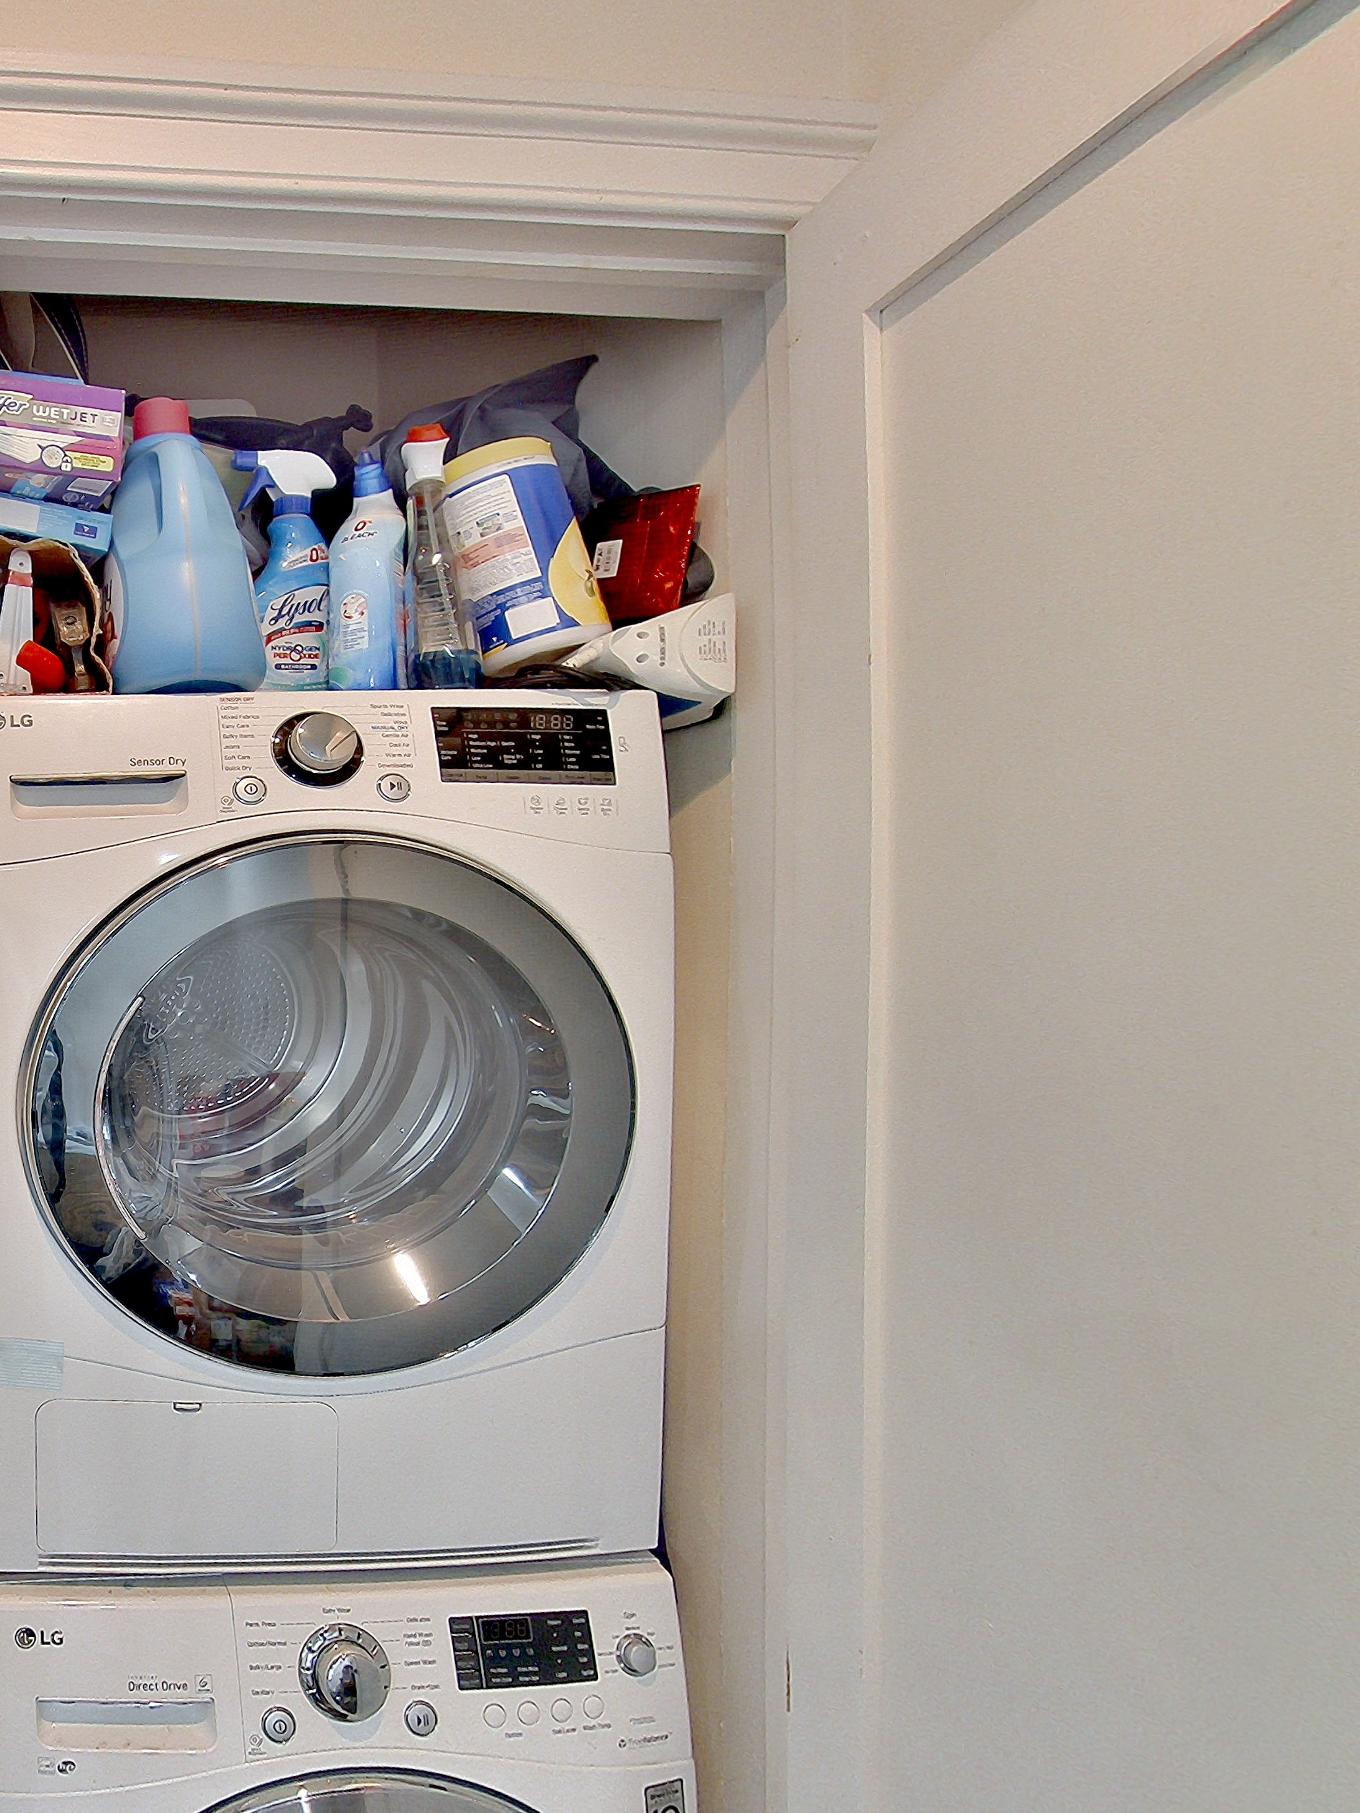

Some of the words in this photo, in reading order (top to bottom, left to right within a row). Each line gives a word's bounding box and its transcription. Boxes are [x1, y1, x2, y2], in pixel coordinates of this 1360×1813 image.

[32, 404, 98, 424] WETJET
[268, 588, 330, 627] Lysol
[9, 714, 34, 728] LG
[129, 757, 166, 768] Sensor
[168, 756, 187, 768] Dry
[40, 1630, 64, 1646] LG
[128, 1681, 159, 1692] Direct
[161, 1680, 188, 1692] Drive
